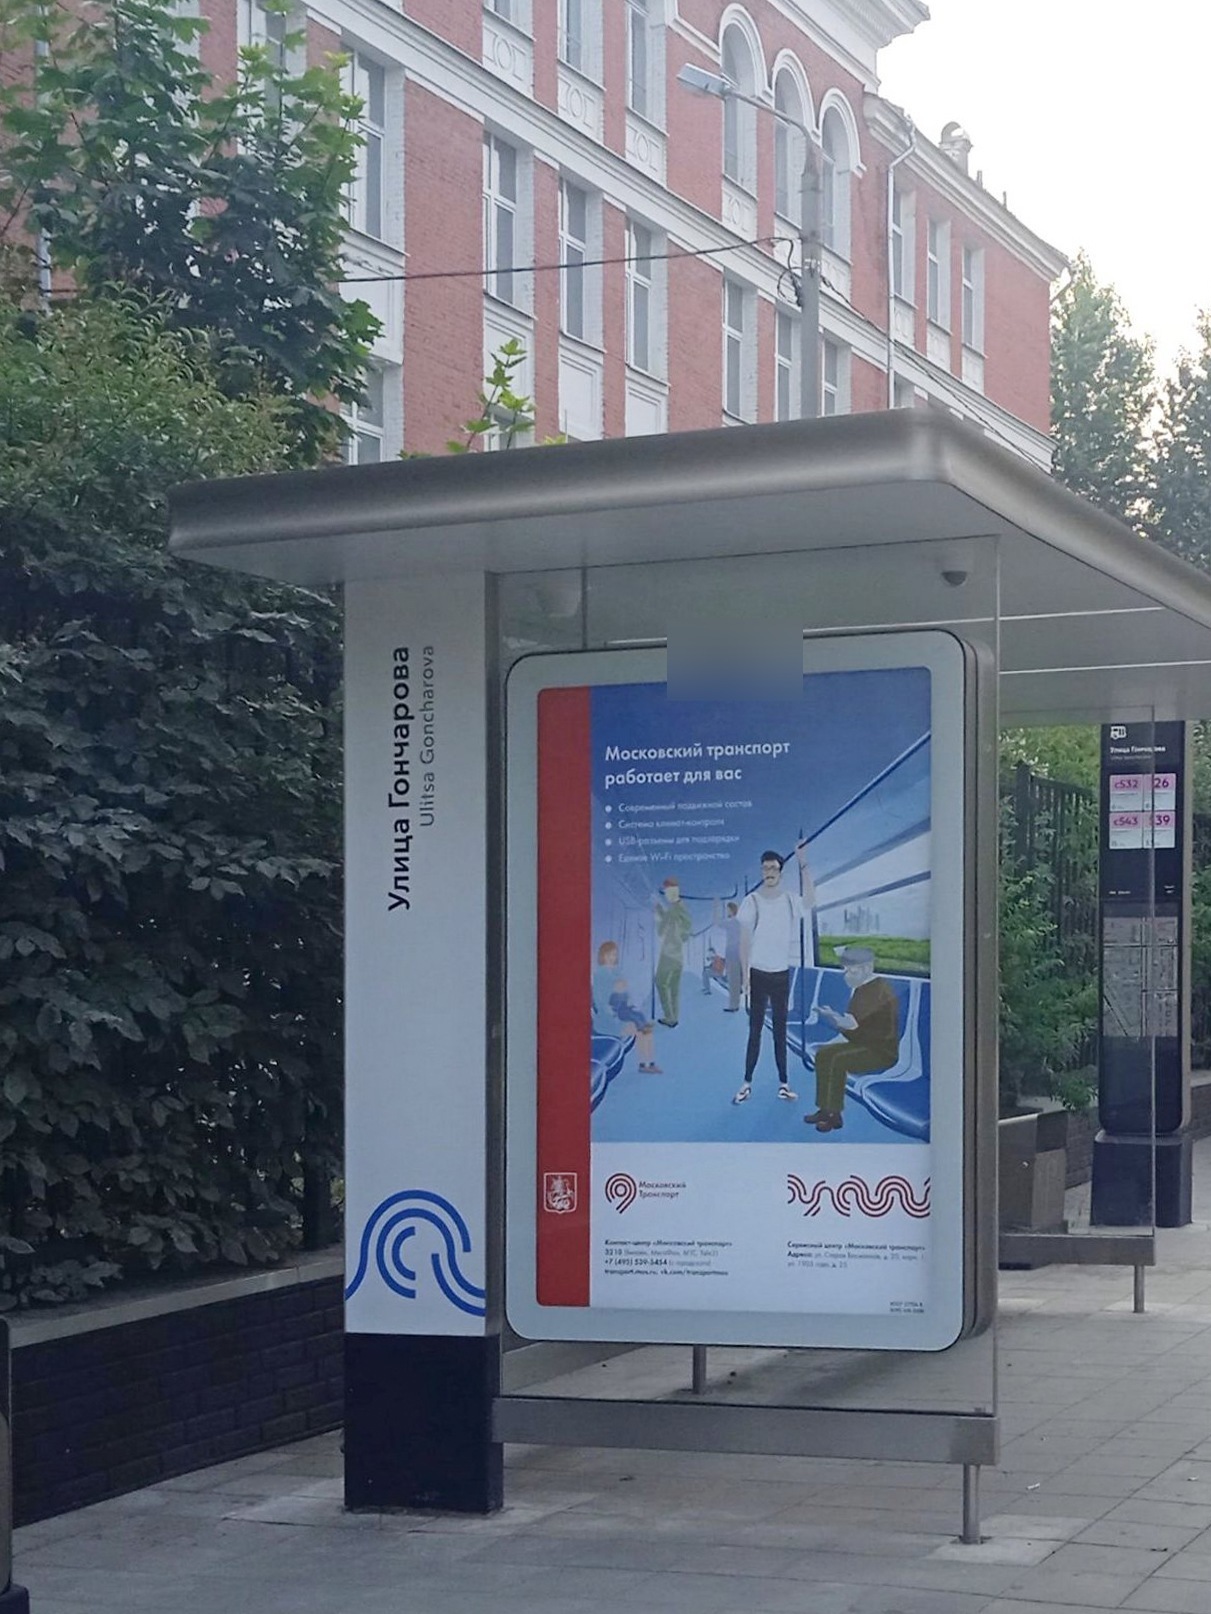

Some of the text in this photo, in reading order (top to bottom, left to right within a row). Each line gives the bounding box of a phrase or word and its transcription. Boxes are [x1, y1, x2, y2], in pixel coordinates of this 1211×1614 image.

[419, 645, 435, 827] Ulitsa Goncharova
[605, 742, 791, 761] Московский транспорт
[388, 647, 415, 911] Улица Гончарова
[605, 768, 742, 789] работает для вас
[1153, 778, 1169, 788] 26
[1155, 815, 1170, 825] 39
